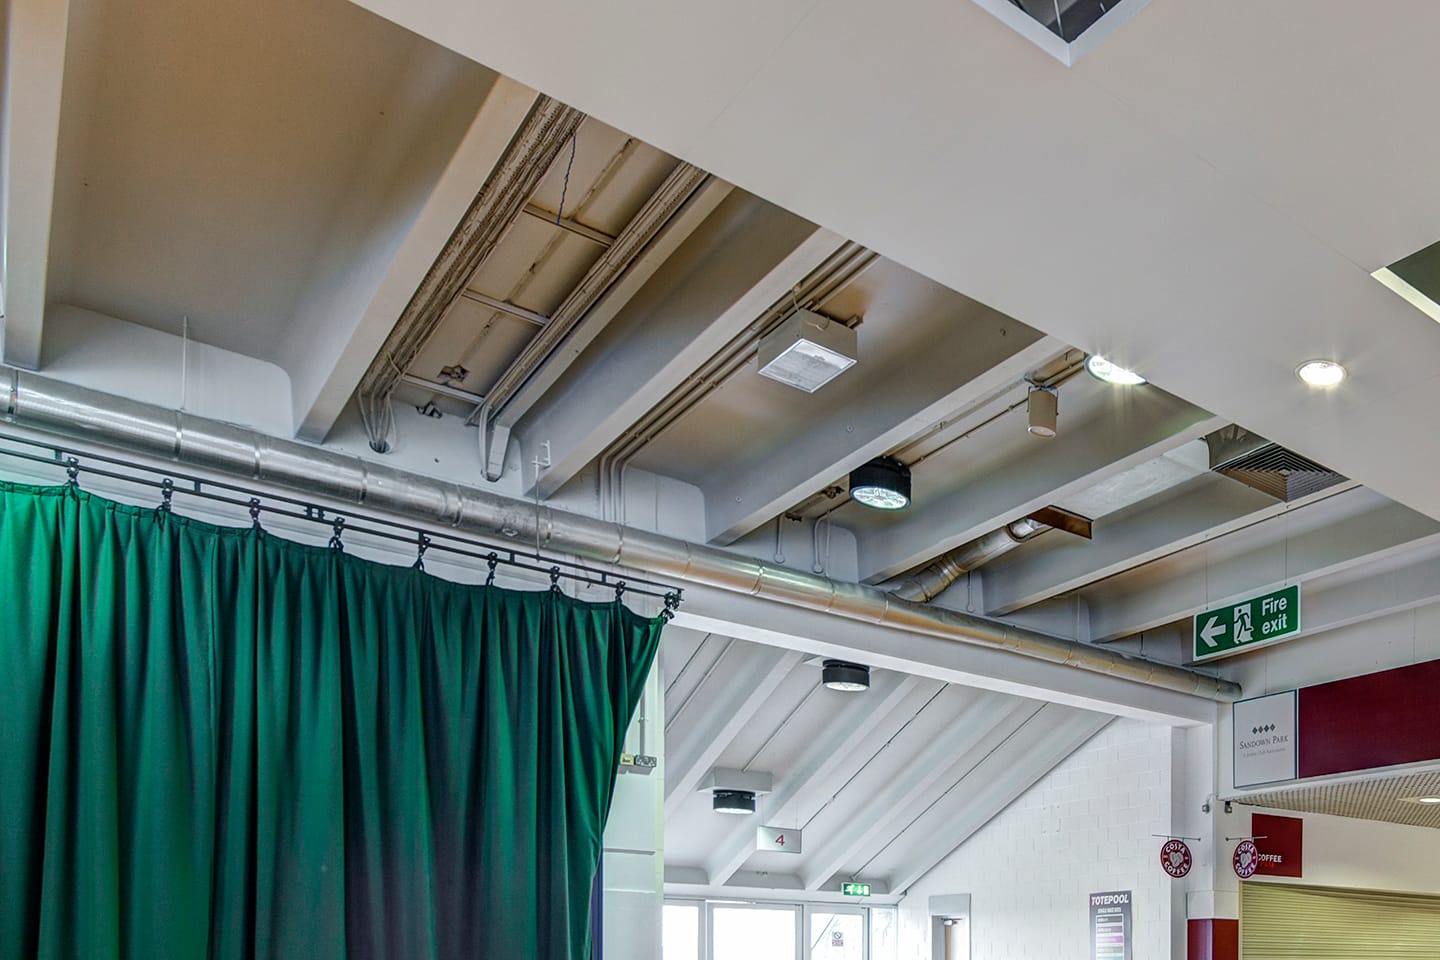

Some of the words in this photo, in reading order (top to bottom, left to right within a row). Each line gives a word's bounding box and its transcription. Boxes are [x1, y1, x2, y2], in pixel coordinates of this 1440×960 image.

[1262, 597, 1287, 616] Fire
[1262, 613, 1287, 634] exit
[775, 834, 785, 846] 4
[1165, 842, 1185, 854] COSTA
[1237, 843, 1254, 854] COSTA
[1164, 860, 1188, 875] COFFEE
[1091, 894, 1129, 906] TOTEPOOL
